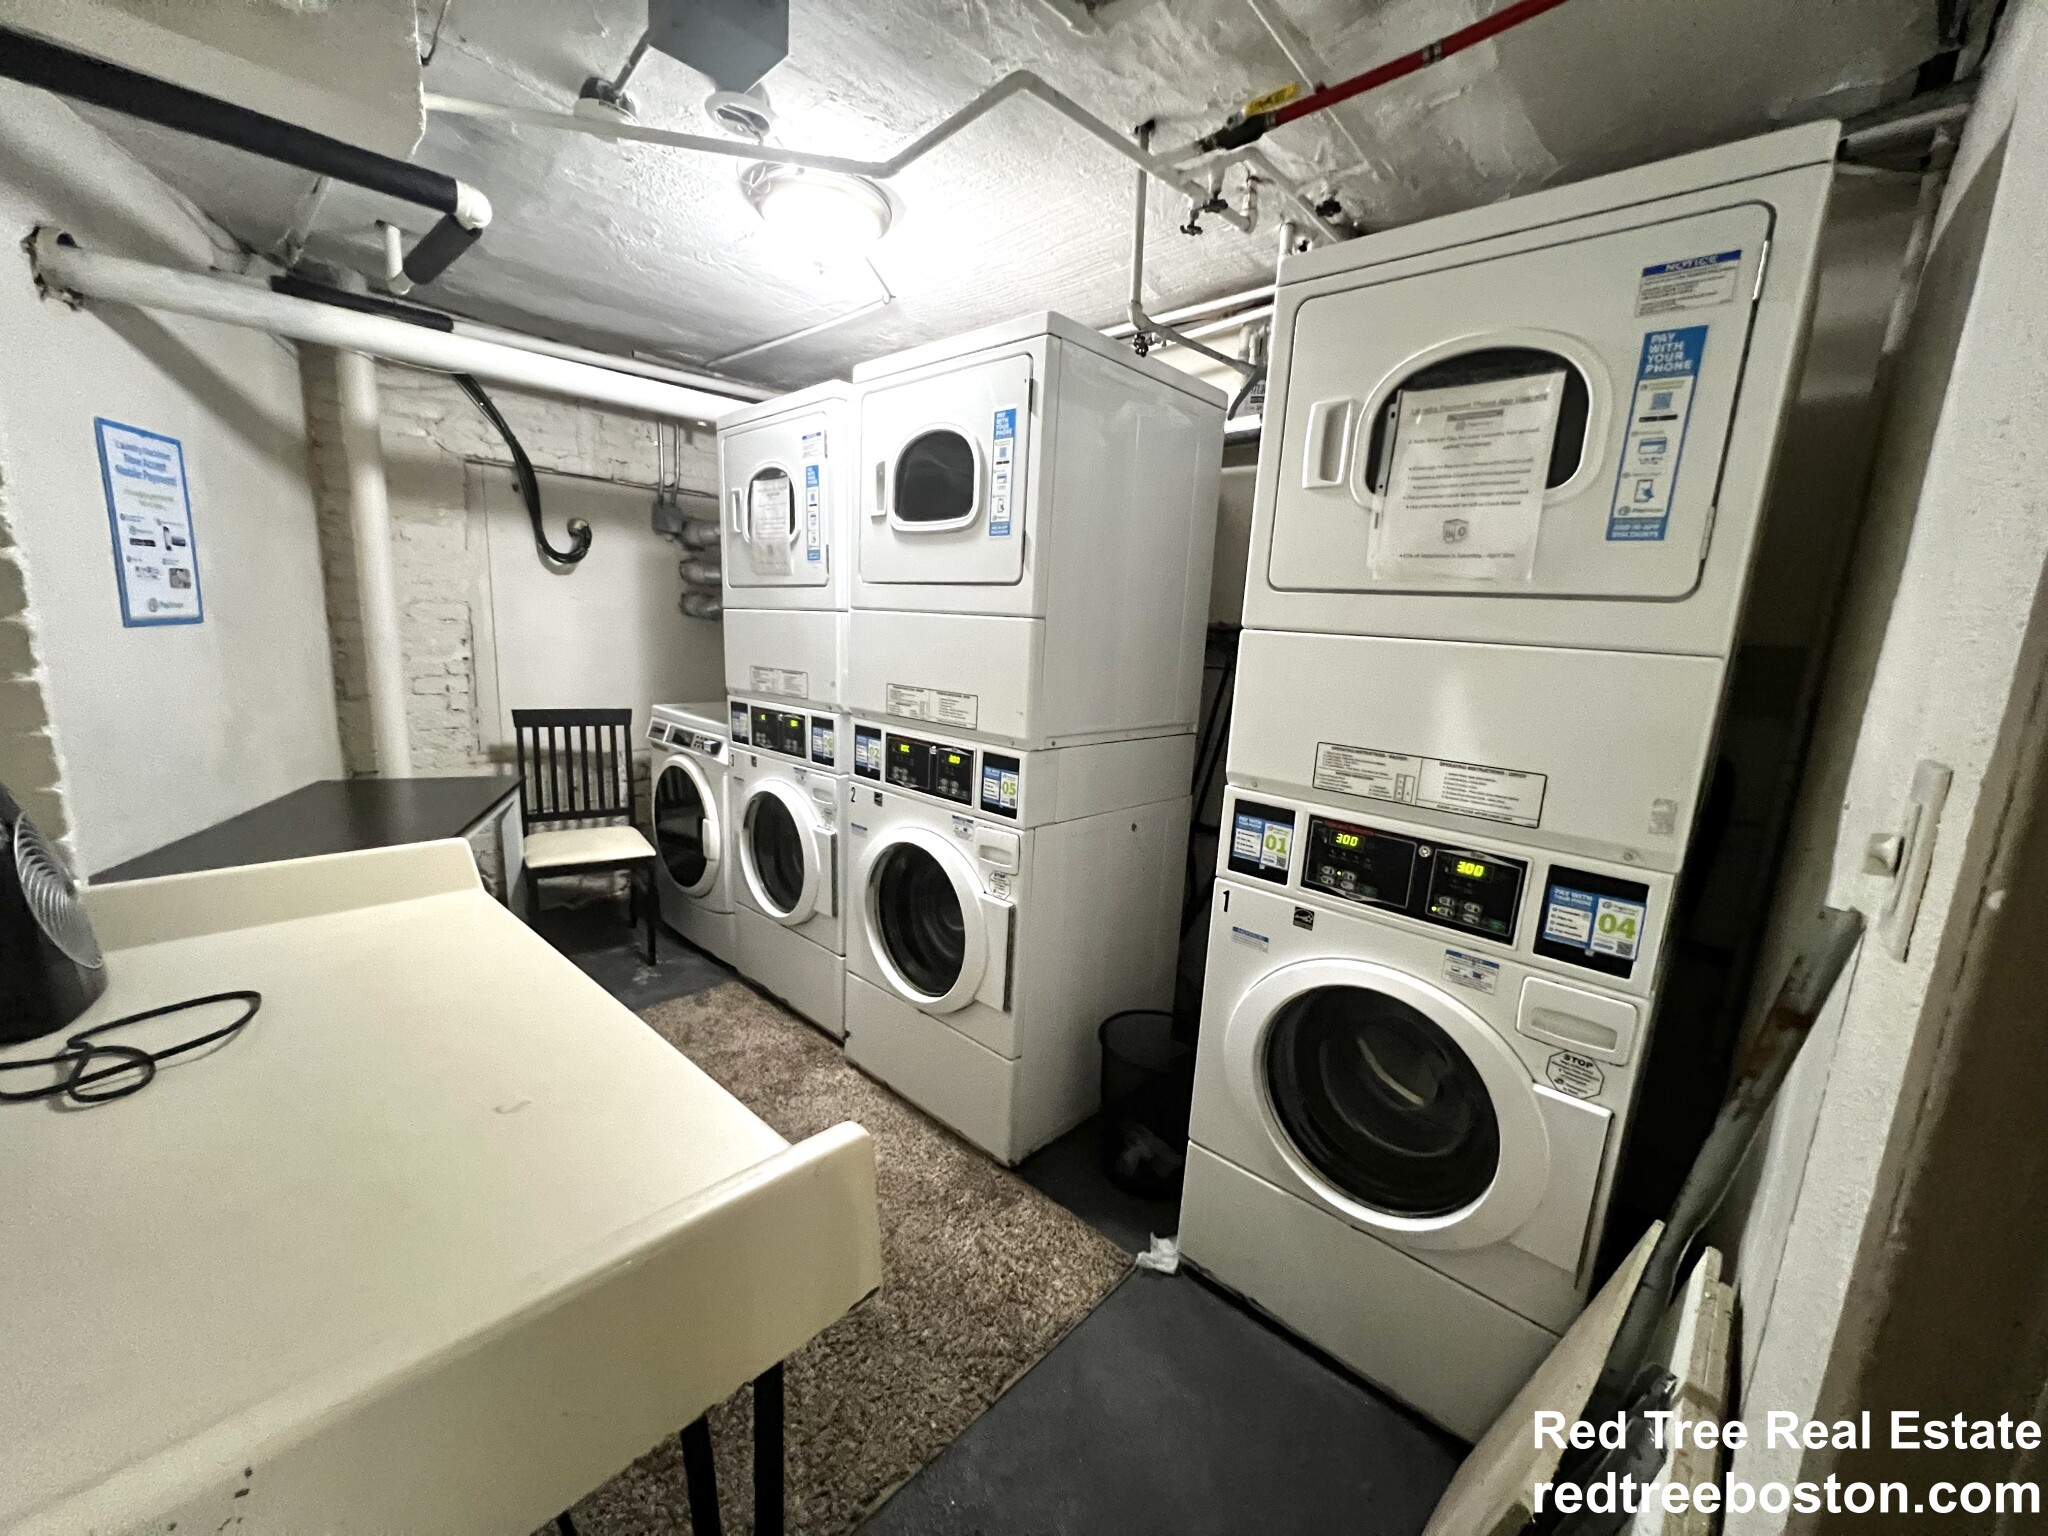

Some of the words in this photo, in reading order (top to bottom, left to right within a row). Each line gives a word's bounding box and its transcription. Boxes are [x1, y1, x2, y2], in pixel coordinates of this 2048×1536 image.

[1665, 254, 1719, 272] NOTICE
[1651, 332, 1676, 344] PAY
[1649, 341, 1685, 354] WITH
[1647, 351, 1685, 363] YOUR
[1645, 359, 1693, 374] PHONE
[850, 787, 856, 803] 2
[1002, 781, 1017, 797] 05
[1265, 834, 1287, 855] 01
[1335, 832, 1359, 848] 300
[1456, 860, 1485, 878] 300
[1223, 889, 1230, 913] 1
[1554, 888, 1570, 897] PAY
[1571, 891, 1593, 902] WITH
[1598, 912, 1636, 940] 04
[1563, 1053, 1594, 1069] STOP
